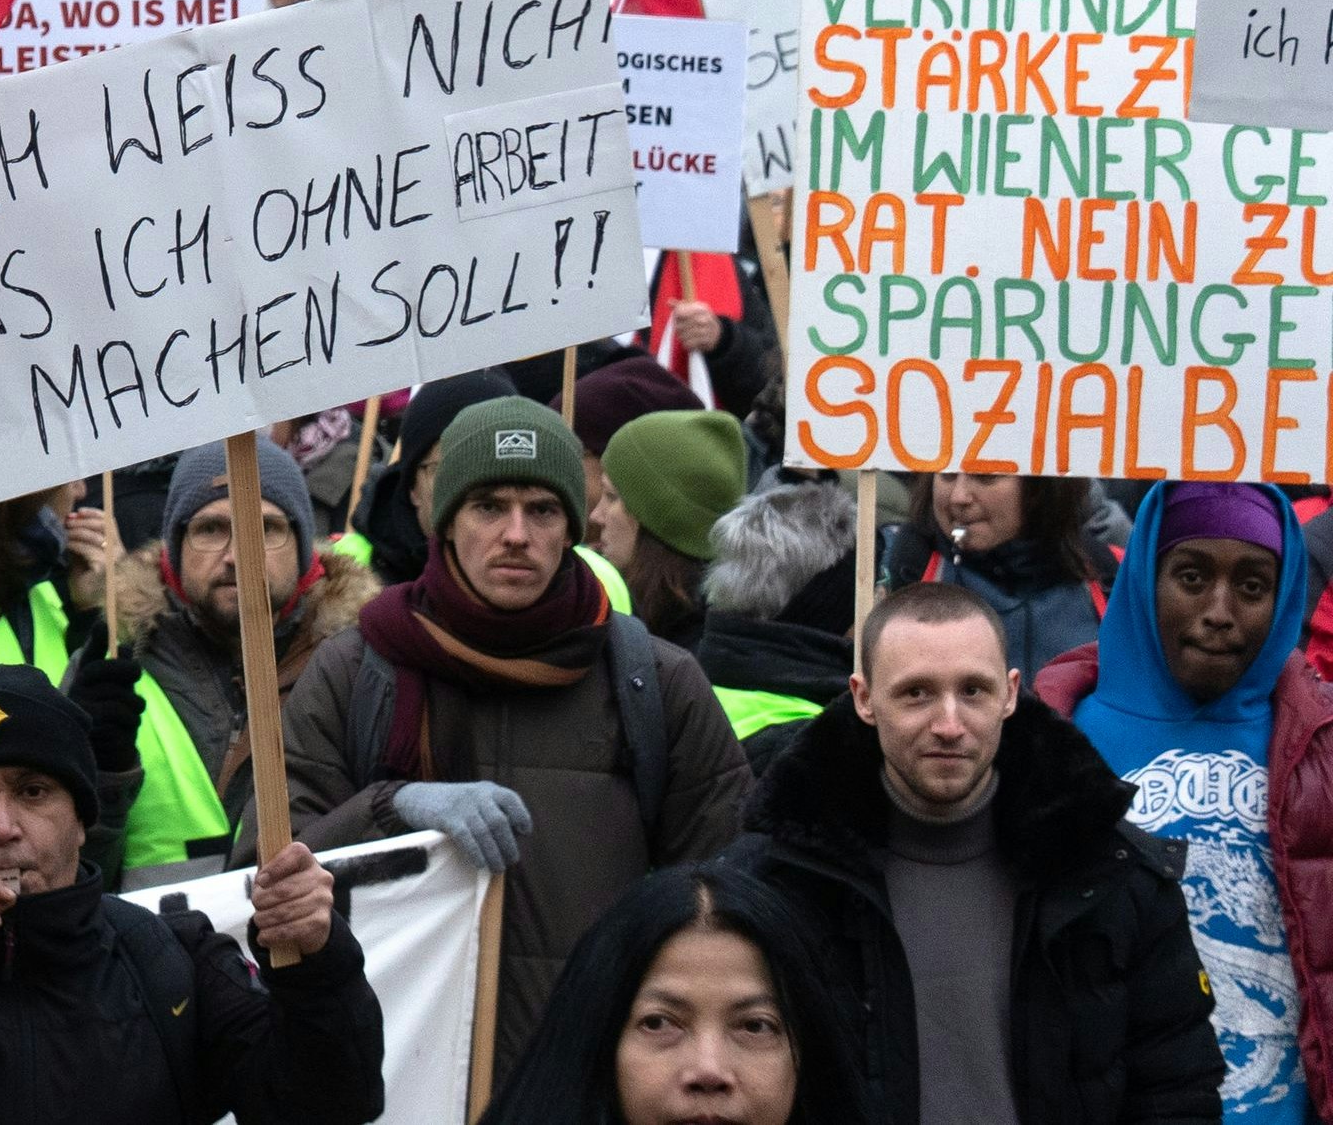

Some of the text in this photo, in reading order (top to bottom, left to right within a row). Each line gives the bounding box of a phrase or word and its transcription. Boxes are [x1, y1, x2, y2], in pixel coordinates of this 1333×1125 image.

[59, 0, 120, 30] WO
[1242, 7, 1299, 67] ich
[102, 43, 328, 176] WEISS
[807, 24, 1104, 118] STÄRKE
[808, 107, 886, 195] IM
[913, 111, 1193, 203] WIENER
[93, 203, 213, 313] ICH
[252, 141, 435, 264] OHNE
[452, 107, 626, 211] ARBEIT
[803, 190, 980, 278] RAT.
[1021, 195, 1199, 285] NEIN
[28, 269, 342, 456] MACHEN
